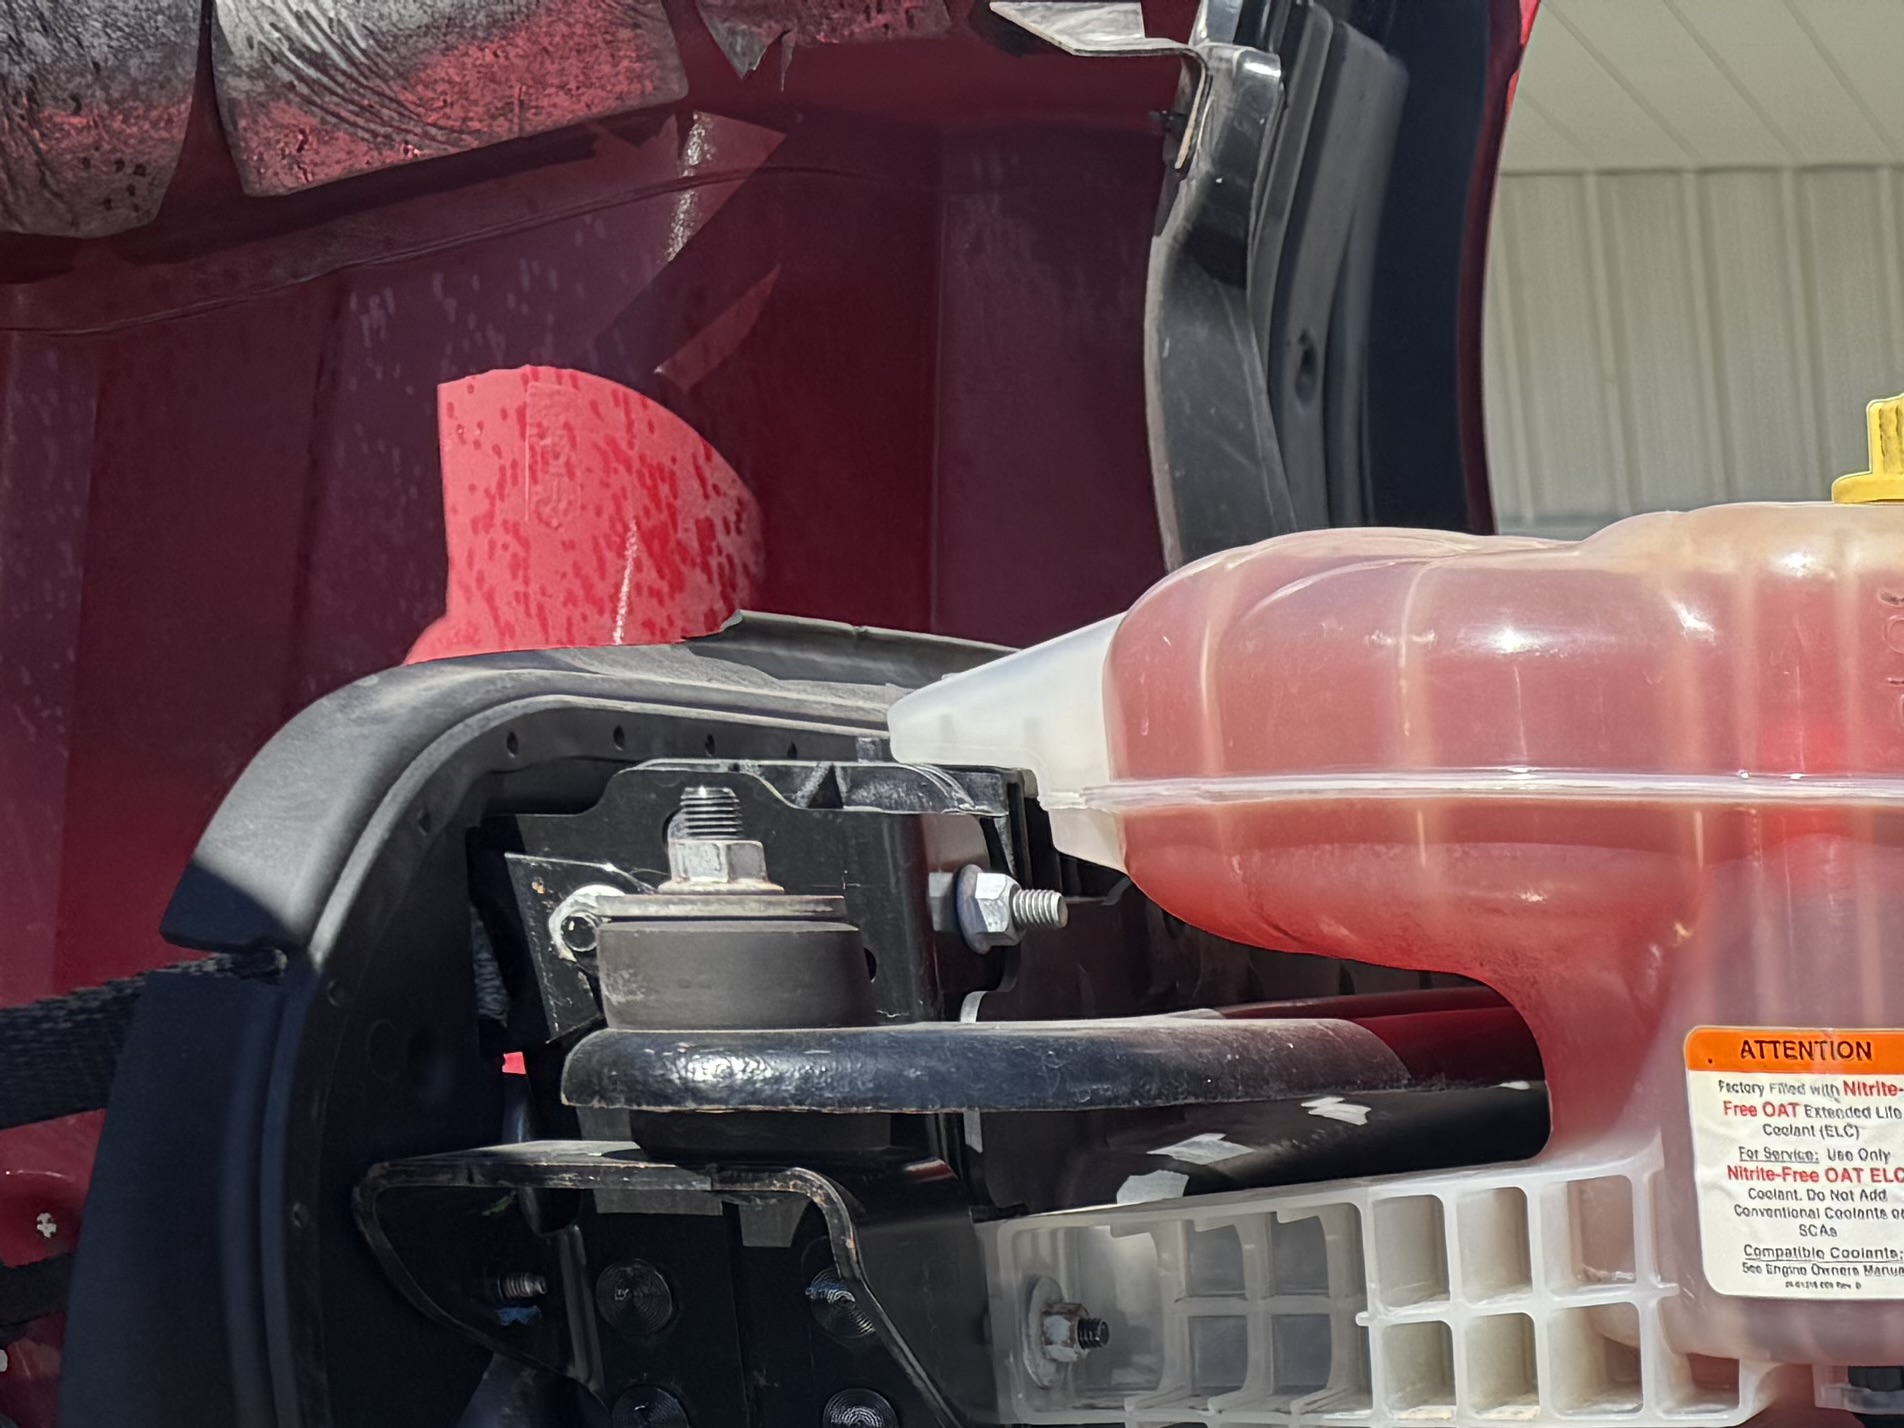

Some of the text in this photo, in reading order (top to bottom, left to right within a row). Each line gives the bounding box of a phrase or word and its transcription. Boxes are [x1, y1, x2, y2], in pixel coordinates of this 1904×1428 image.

[1740, 1040, 1872, 1061] ATTENTION
[1718, 1079, 1904, 1097] Factory Filled with Nitrite-
[1724, 1101, 1902, 1119] Free OAT Extended Life
[1763, 1124, 1860, 1139] Coolant (ELC)
[1739, 1147, 1891, 1165] For Service: Use Only
[1728, 1165, 1820, 1183] Nitrite-Free
[1825, 1167, 1864, 1183] OAT
[1748, 1188, 1887, 1202] Coolant. Do Not Add
[1734, 1205, 1820, 1219] Conventional
[1824, 1206, 1888, 1220] Coolants
[1798, 1224, 1838, 1237] SCAs
[1744, 1244, 1904, 1261] Compatible Coolants:
[1742, 1263, 1762, 1274] See
[1766, 1263, 1807, 1277] Engine
